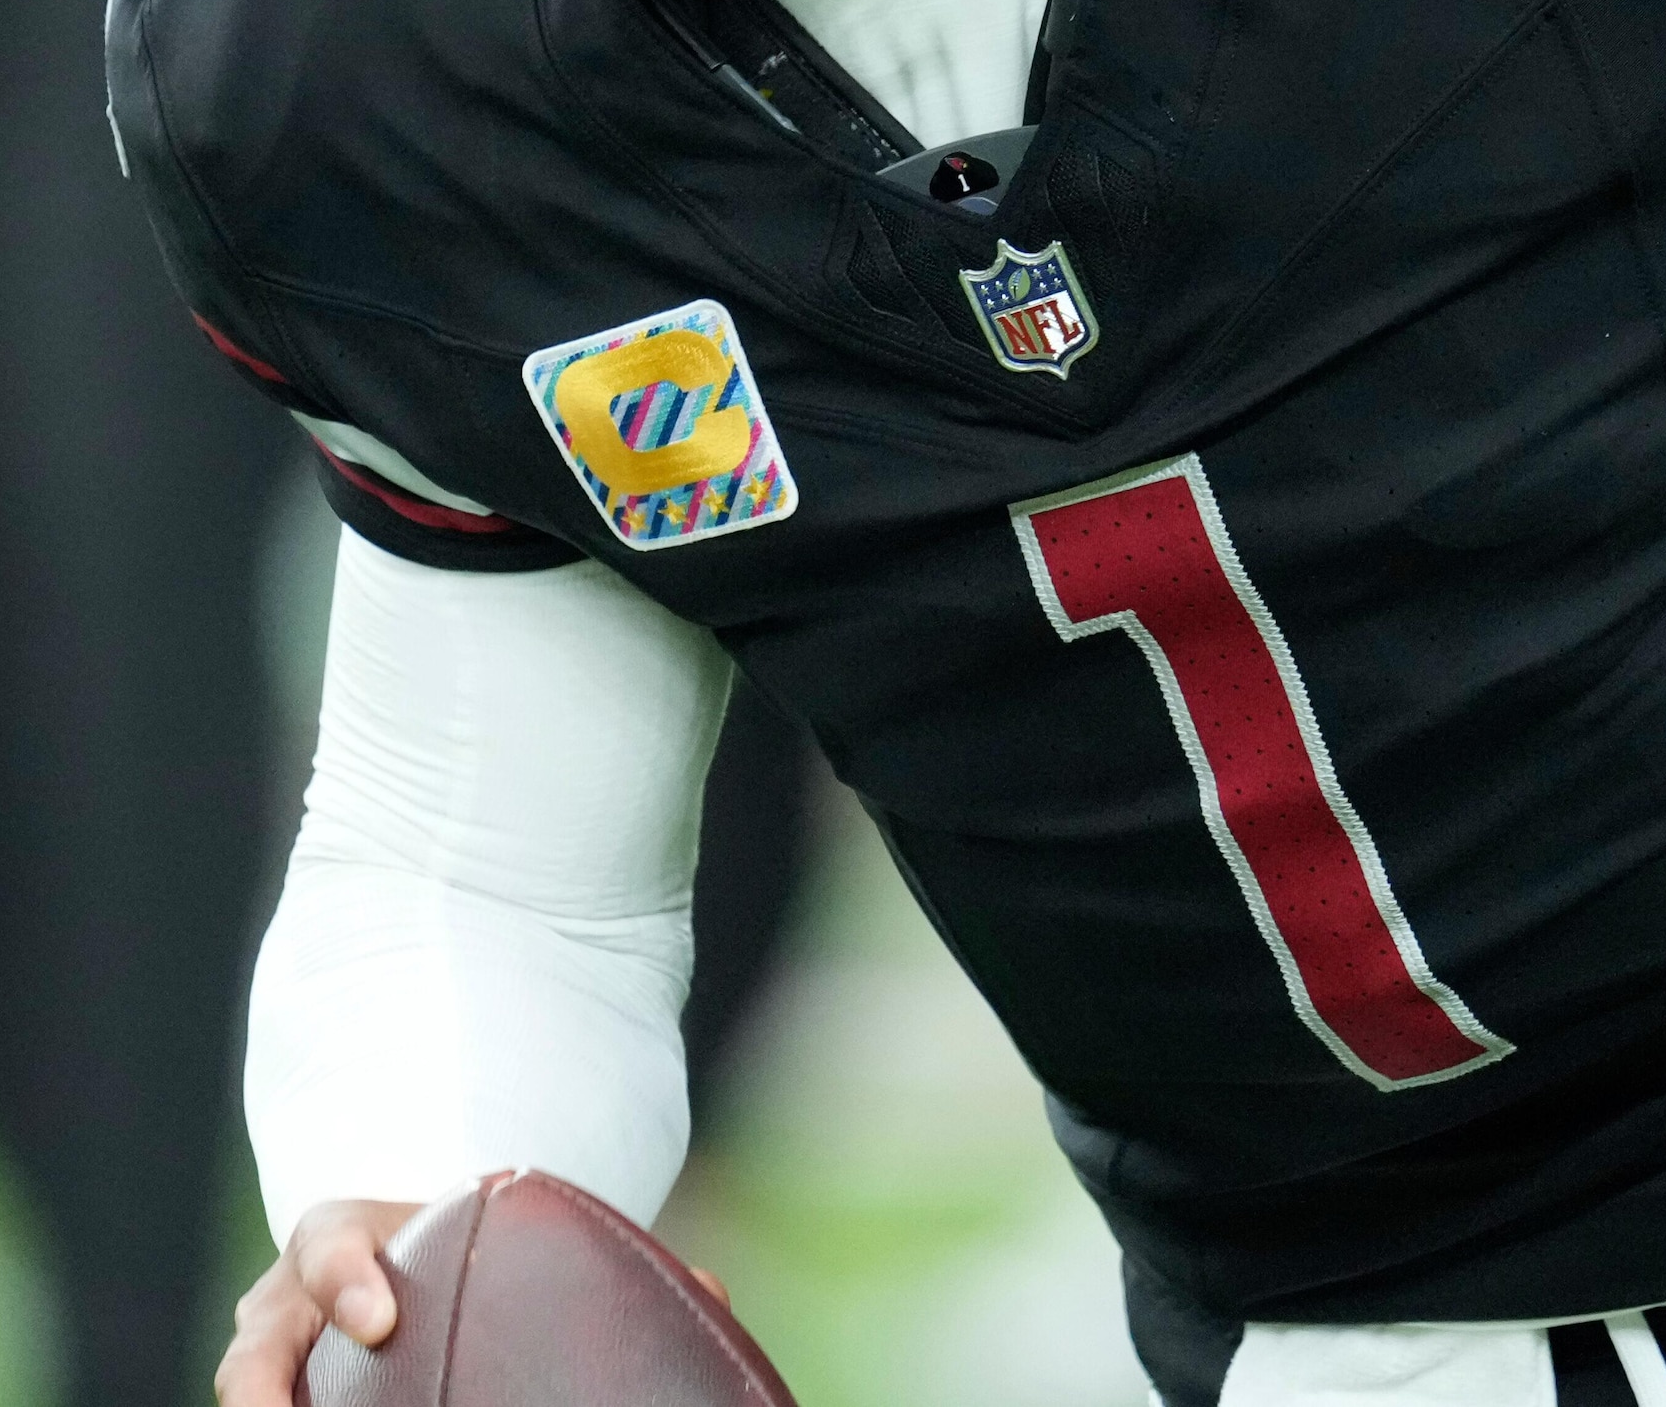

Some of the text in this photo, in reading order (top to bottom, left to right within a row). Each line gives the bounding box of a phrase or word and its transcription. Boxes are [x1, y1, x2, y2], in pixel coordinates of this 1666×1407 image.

[958, 174, 970, 192] 1
[996, 299, 1081, 355] NFL
[554, 329, 753, 496] C
[1007, 451, 1517, 1092] 1
